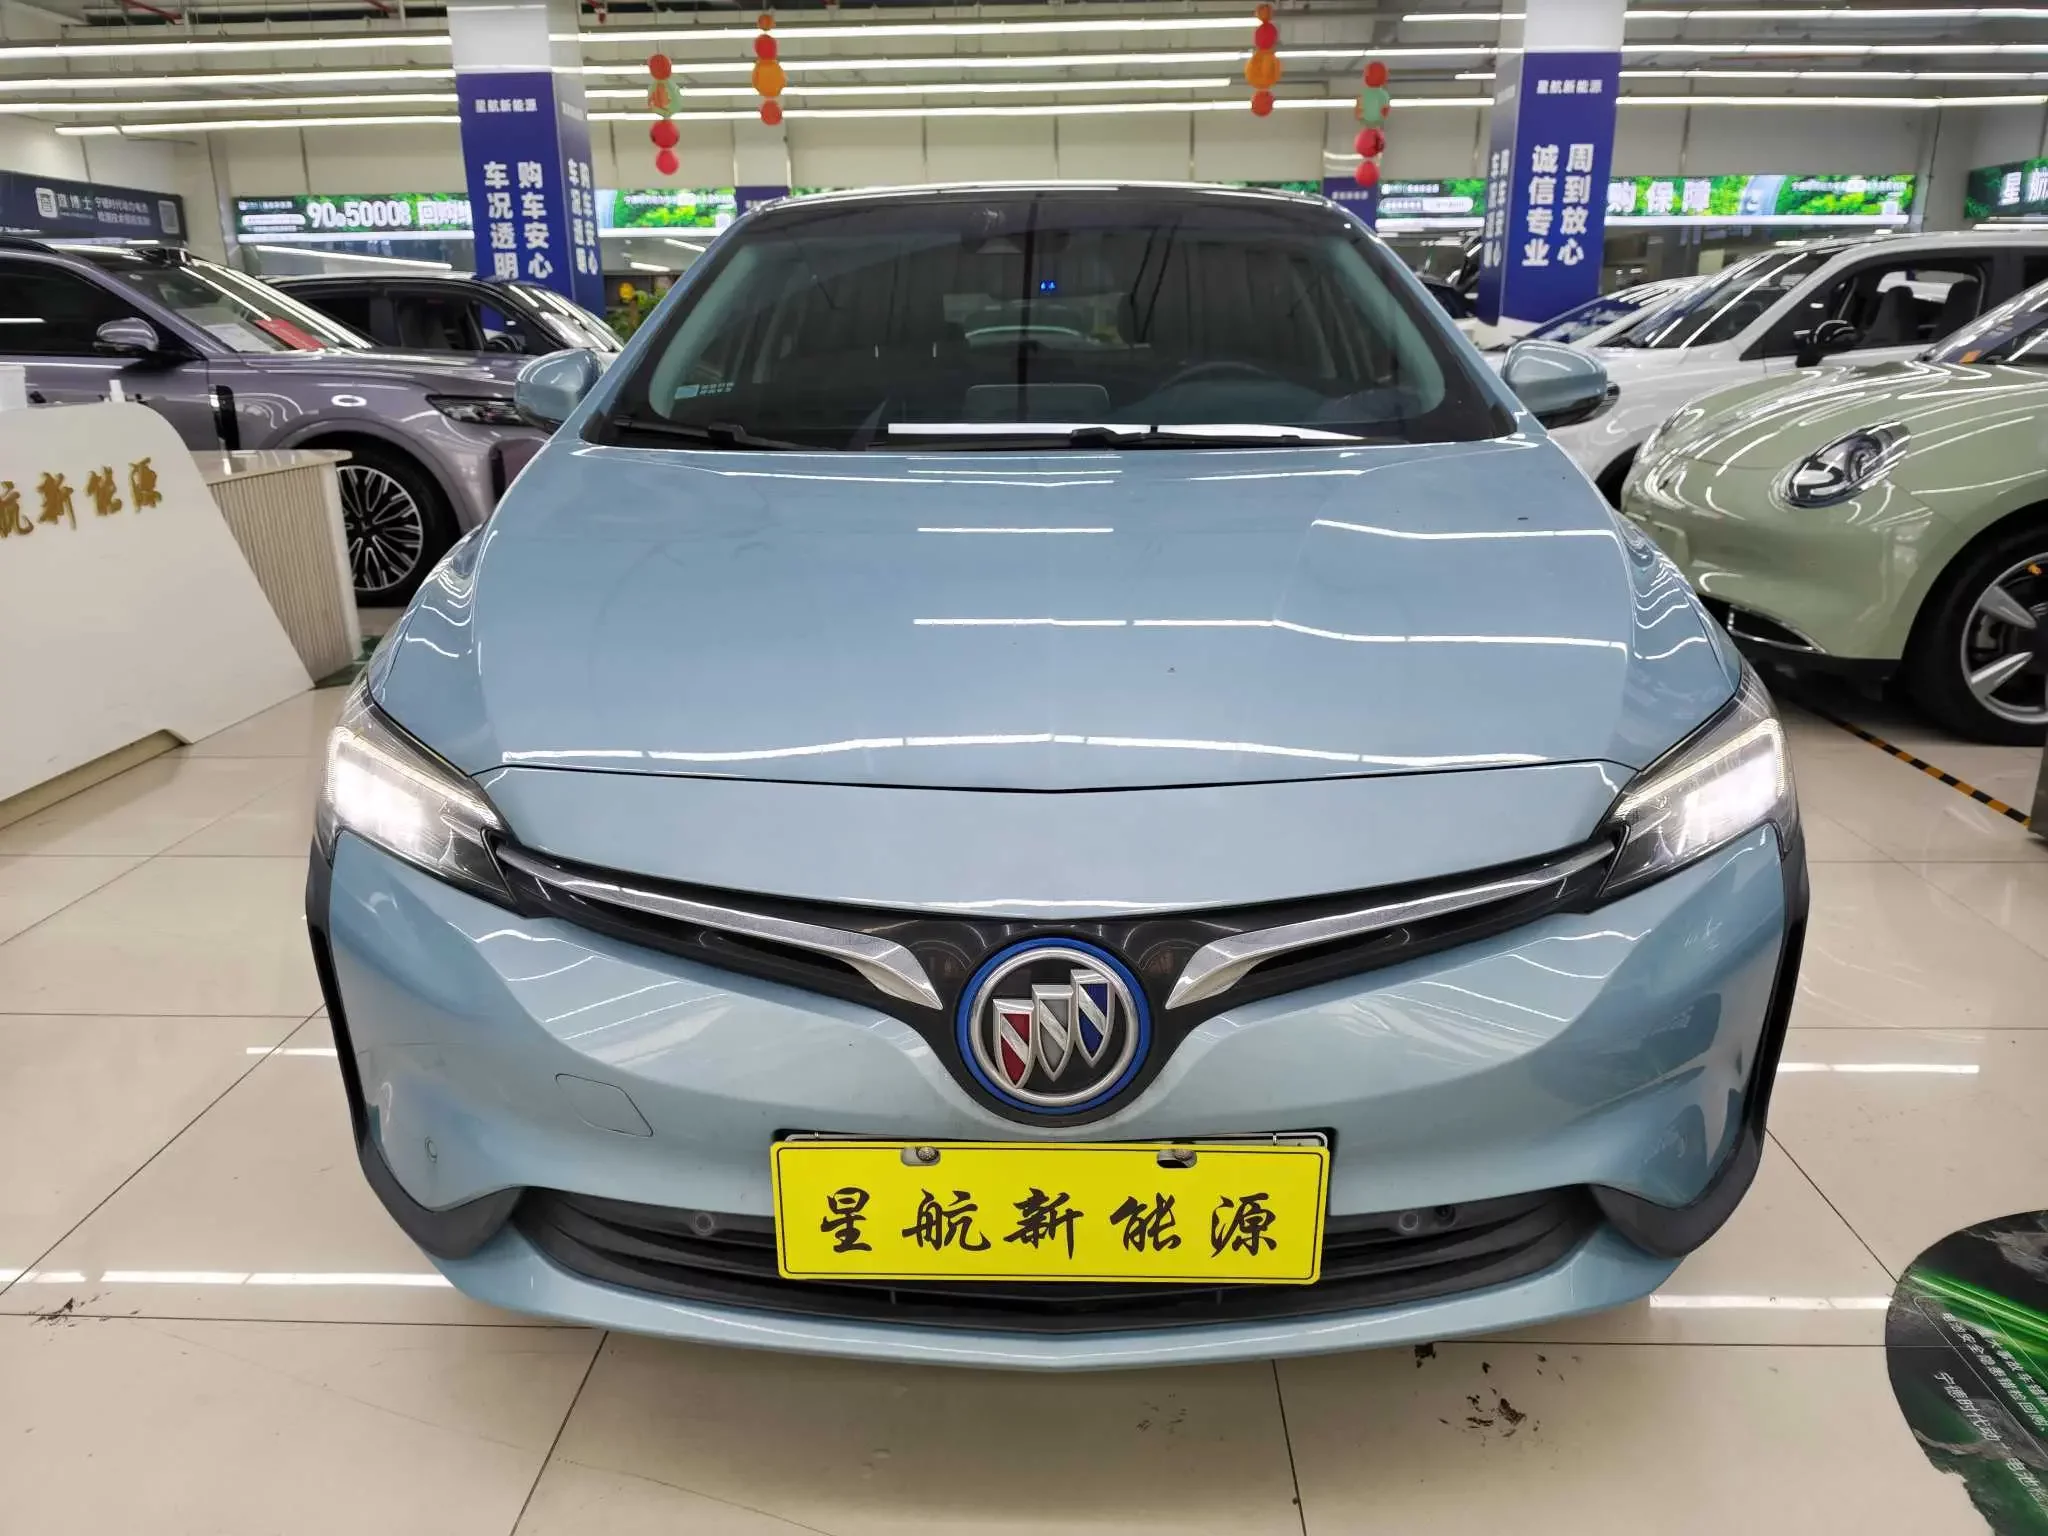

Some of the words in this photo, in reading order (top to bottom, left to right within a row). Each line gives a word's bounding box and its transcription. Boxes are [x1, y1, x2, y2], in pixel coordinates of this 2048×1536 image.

[484, 160, 519, 281] 车况透明
[517, 160, 554, 279] 购车安心
[1521, 144, 1559, 266] 诚信专业
[1556, 143, 1594, 265] 周到放心
[820, 1187, 1278, 1260] 星航新能源
